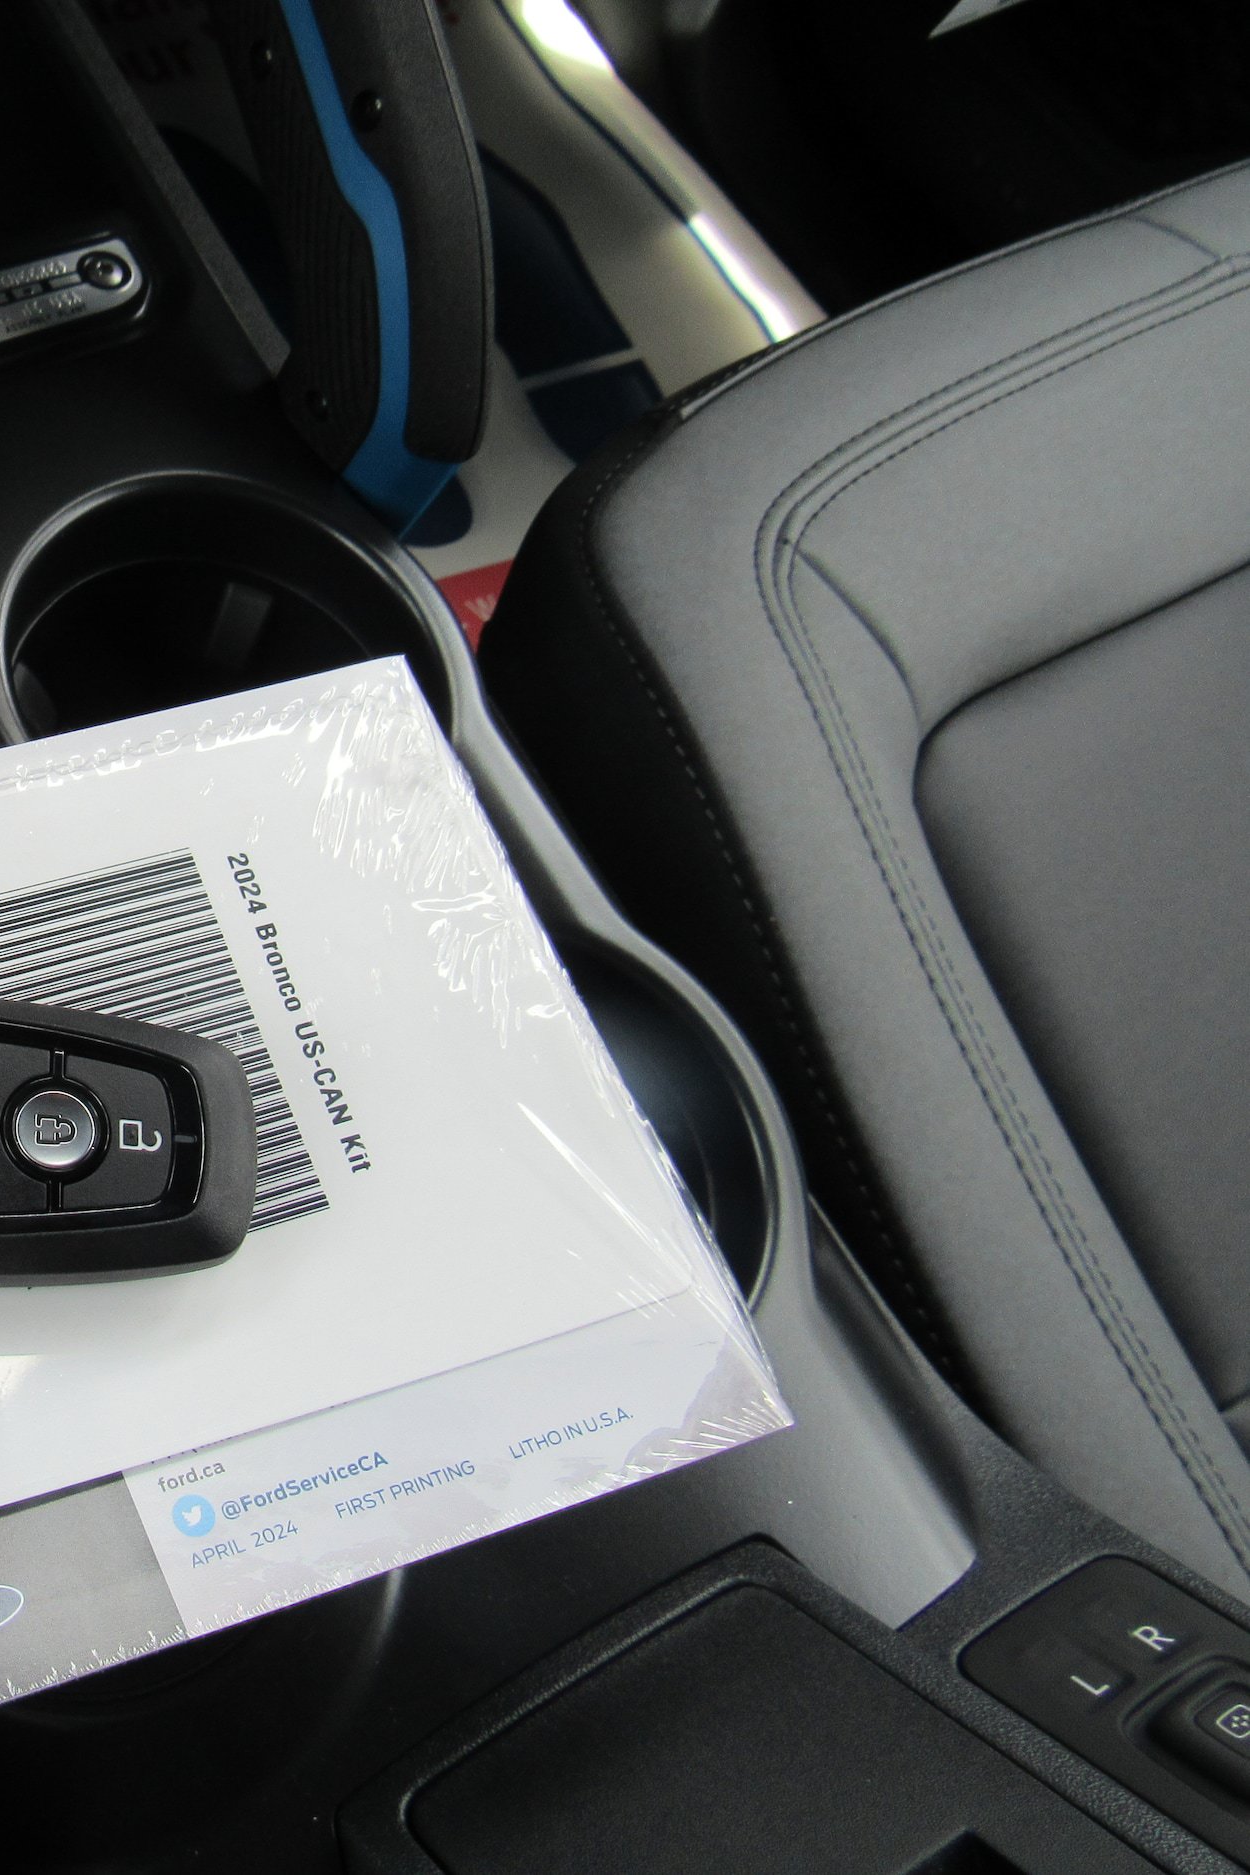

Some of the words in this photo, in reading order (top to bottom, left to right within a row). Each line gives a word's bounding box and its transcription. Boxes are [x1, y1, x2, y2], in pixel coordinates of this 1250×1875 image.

[226, 853, 268, 915] 2024
[255, 922, 303, 1012] Bronco
[294, 1021, 354, 1126] US-CAN
[340, 1133, 373, 1174] Kit
[508, 1428, 563, 1460] LITHO
[563, 1421, 583, 1442] IN
[584, 1406, 635, 1434] U.S.A.
[157, 1459, 226, 1493] ford.ca
[220, 1450, 389, 1523] @FordServiceCA
[334, 1488, 386, 1520] FIRST
[390, 1459, 477, 1503] PRINTING
[191, 1539, 246, 1570] APRIL
[251, 1519, 299, 1551] 2024
[1132, 1626, 1175, 1651] R
[1071, 1675, 1109, 1695] L
